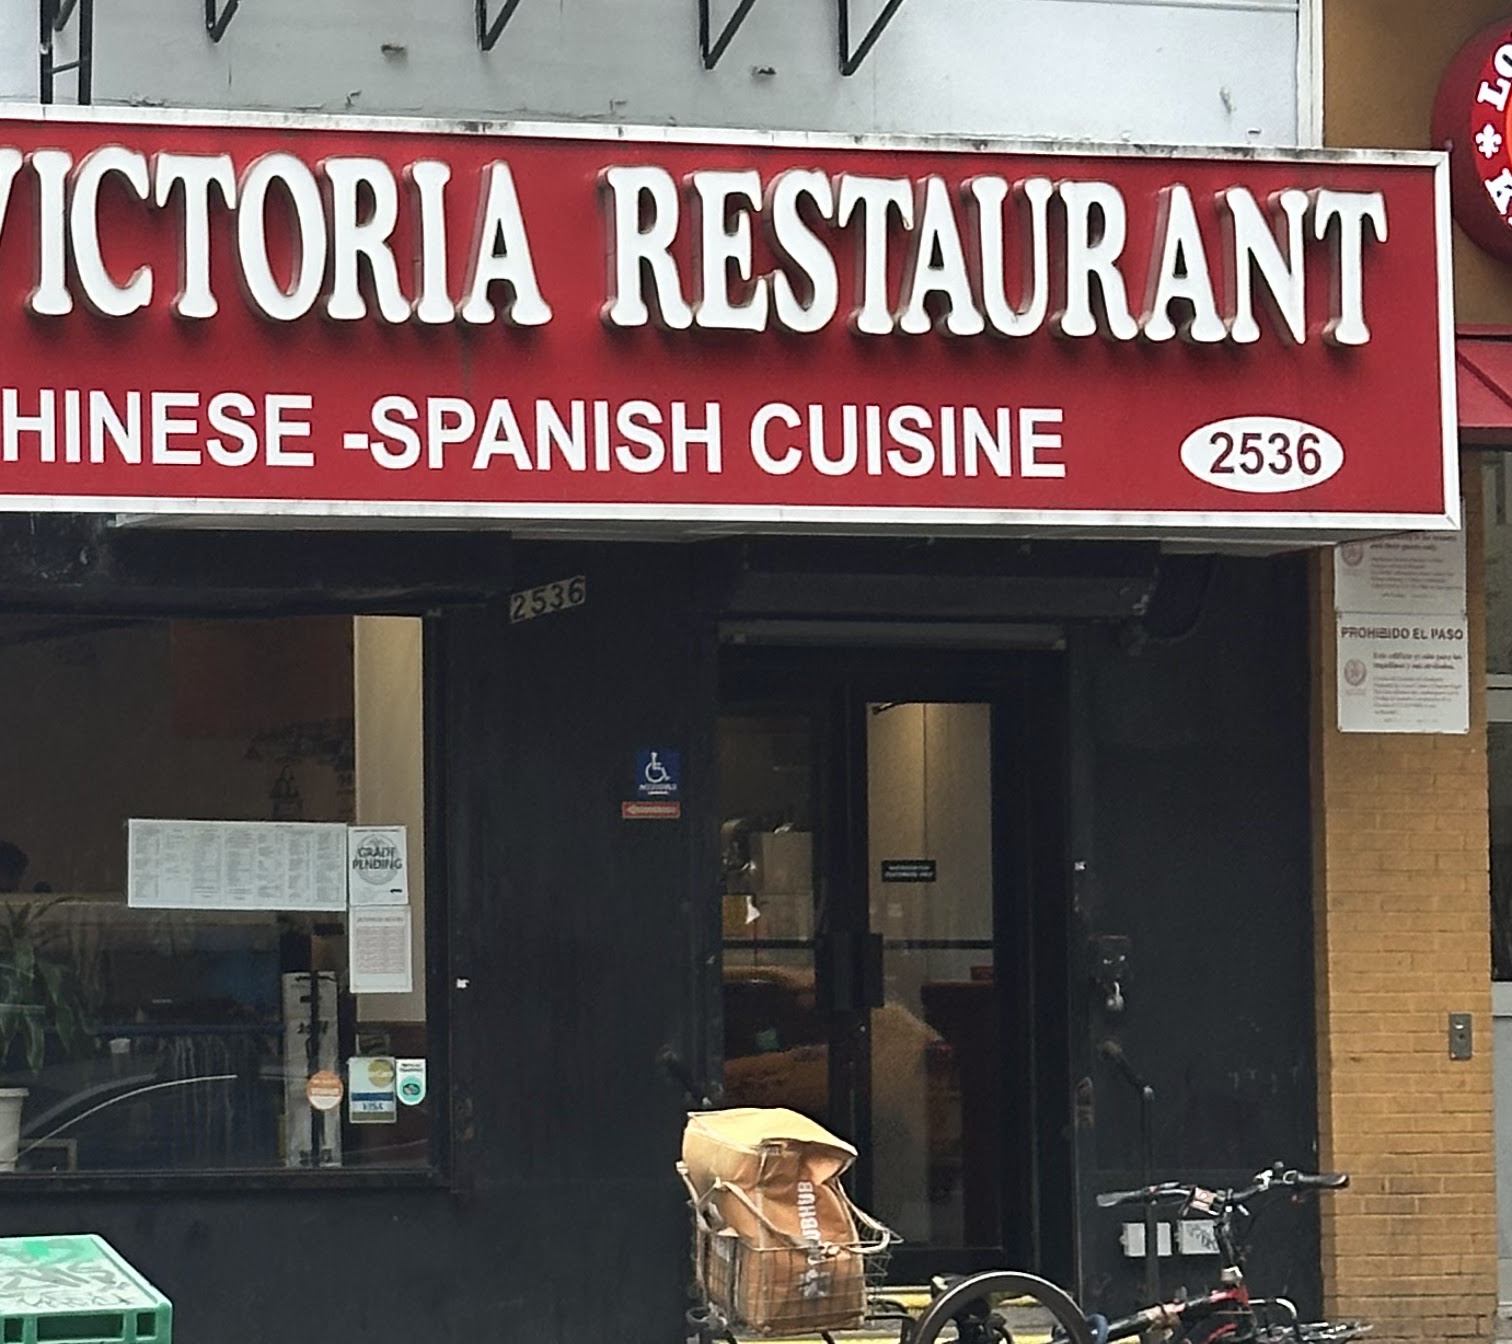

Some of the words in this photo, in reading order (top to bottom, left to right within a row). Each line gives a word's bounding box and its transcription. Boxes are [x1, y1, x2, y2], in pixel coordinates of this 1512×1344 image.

[599, 165, 1388, 346] RESTAURANT
[750, 403, 1066, 479] CUISINE
[1209, 431, 1322, 478] 2536
[511, 576, 585, 621] 2536
[1412, 627, 1428, 640] EL
